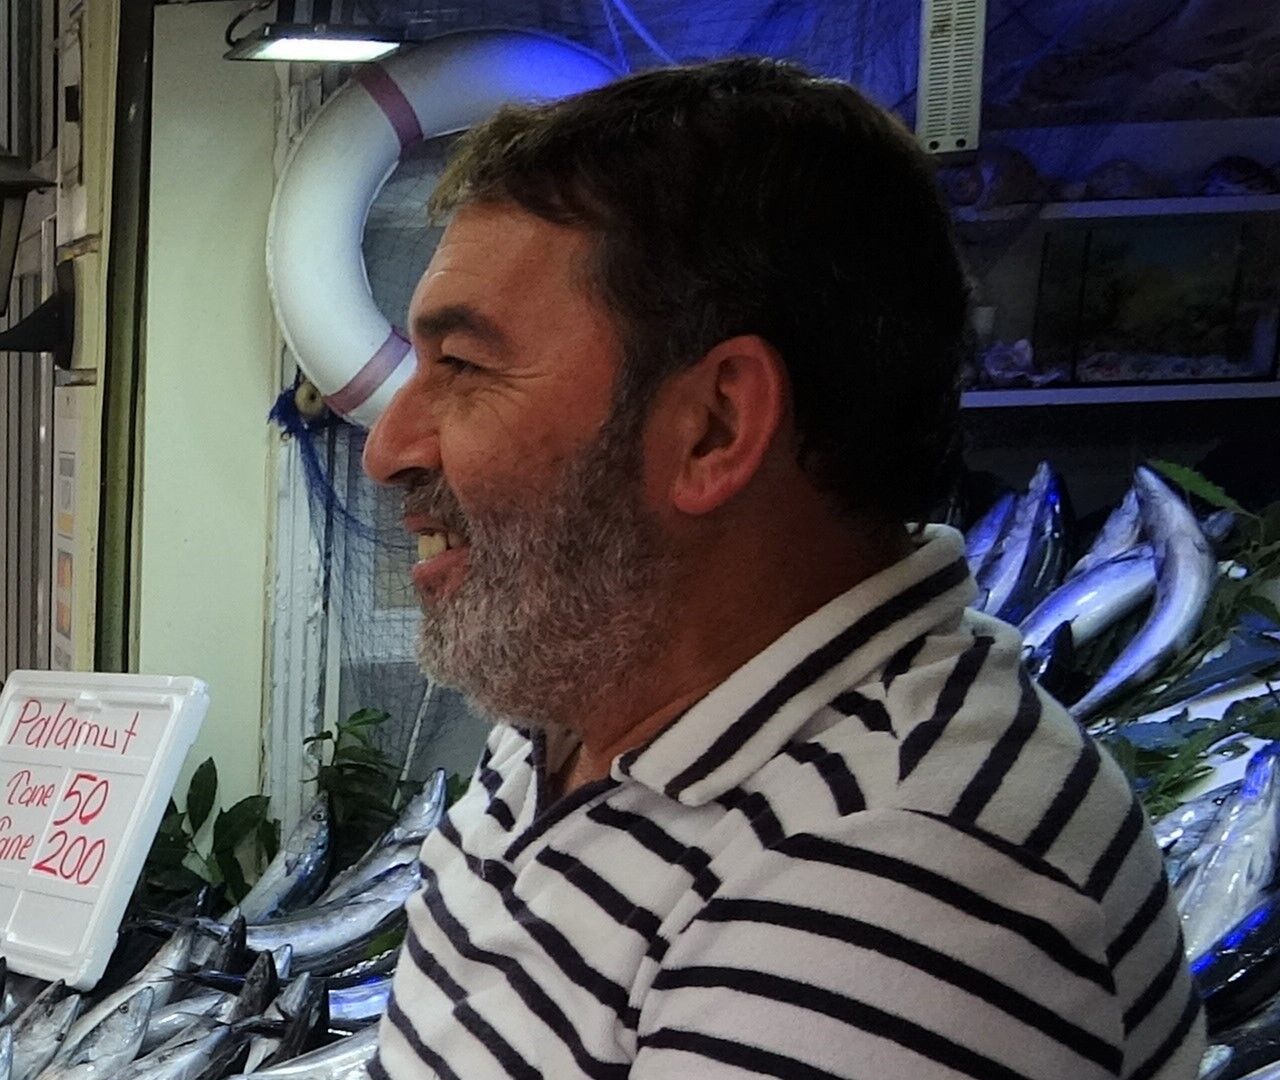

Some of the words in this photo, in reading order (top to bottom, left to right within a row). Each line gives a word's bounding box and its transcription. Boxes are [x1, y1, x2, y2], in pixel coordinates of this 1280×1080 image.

[8, 700, 139, 755] Palamut
[7, 770, 55, 807] Tane
[53, 773, 109, 826] 50
[32, 830, 106, 885] 200
